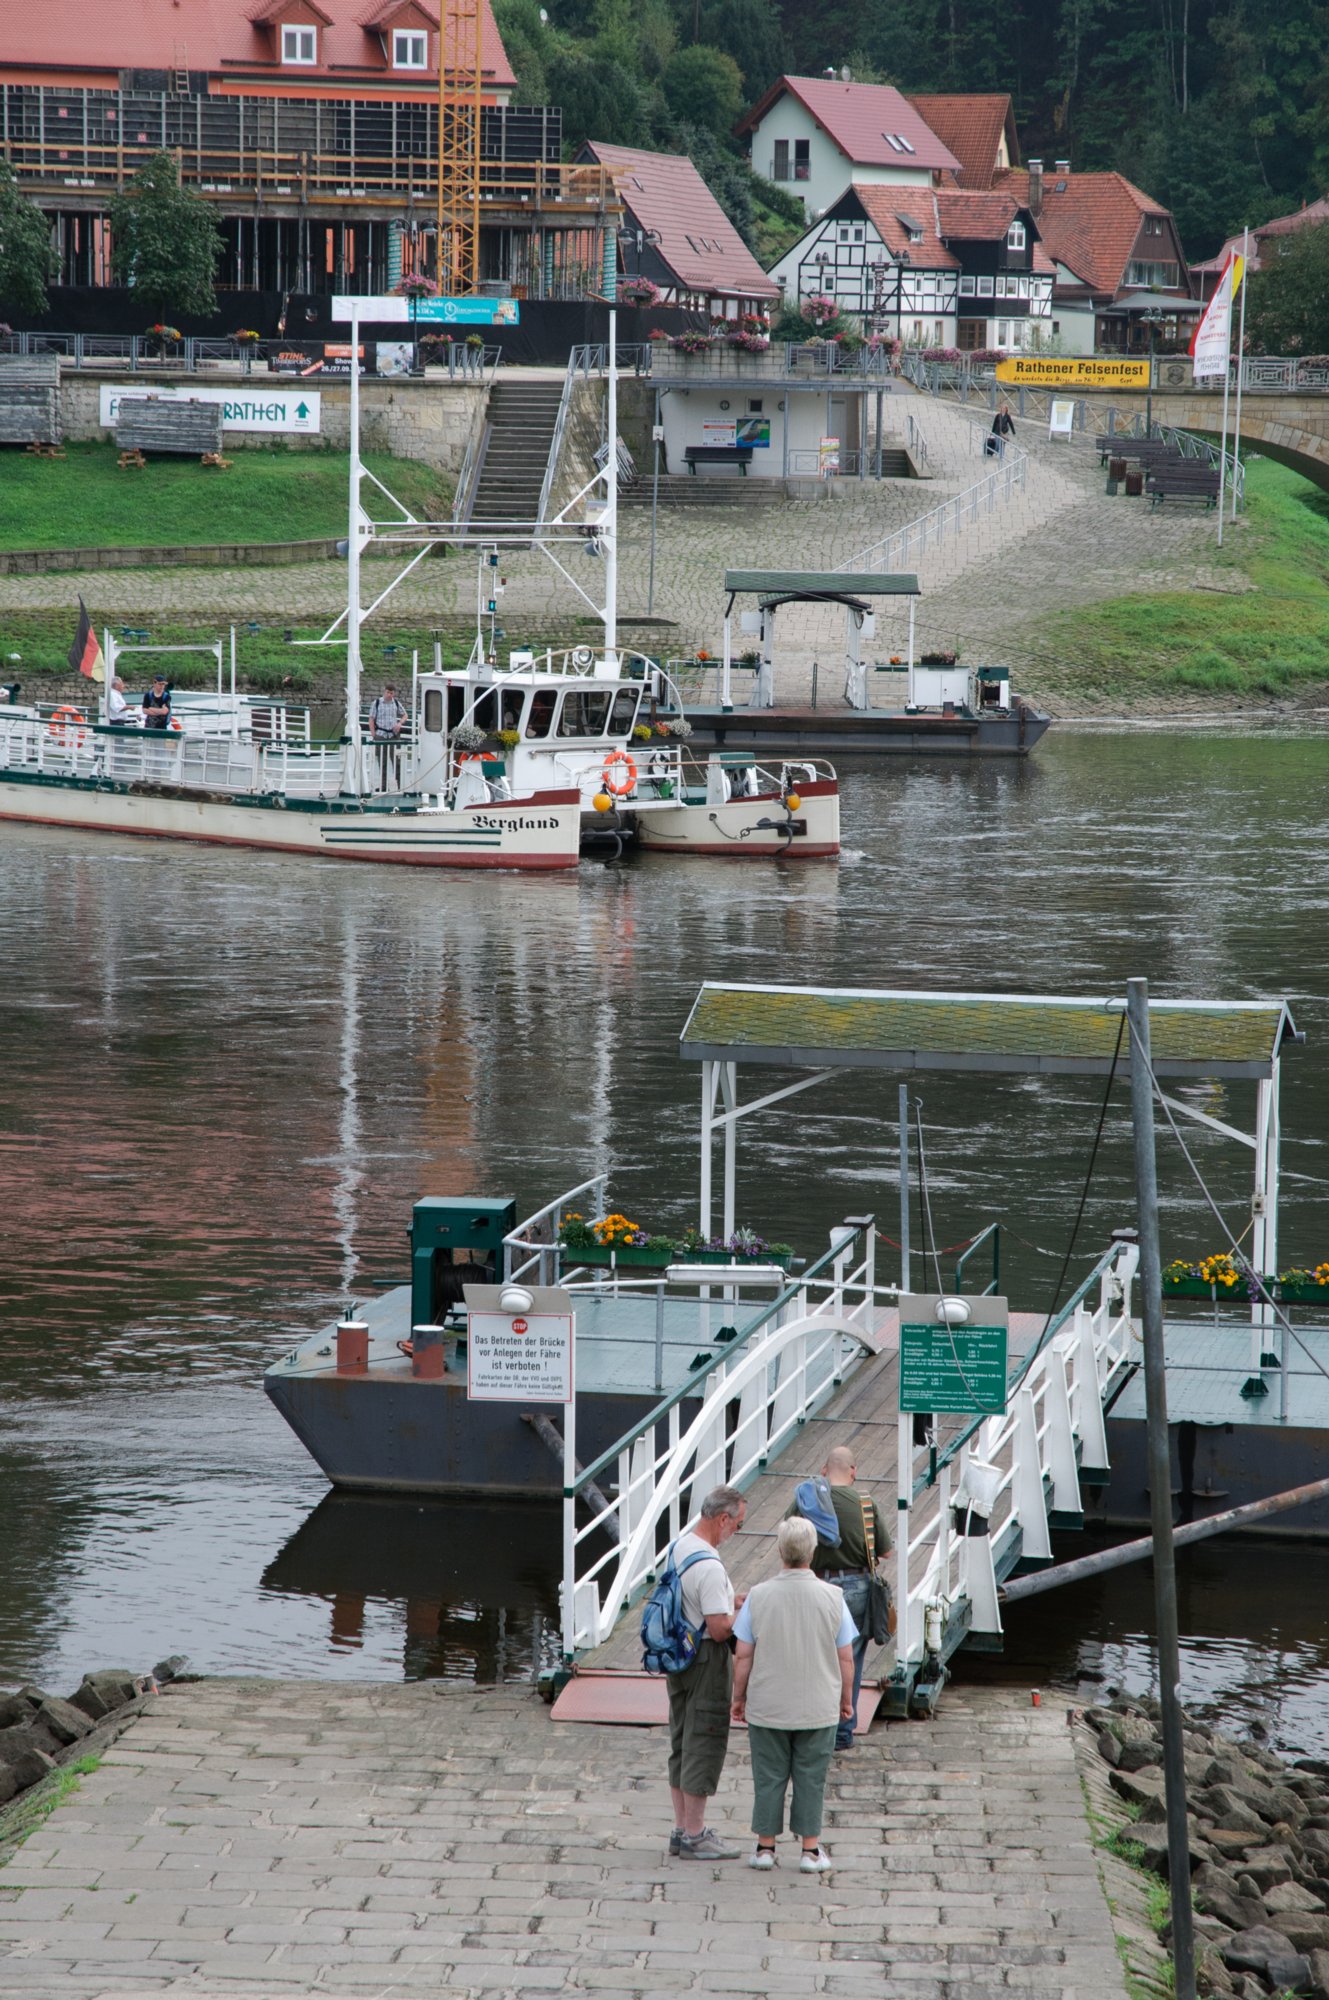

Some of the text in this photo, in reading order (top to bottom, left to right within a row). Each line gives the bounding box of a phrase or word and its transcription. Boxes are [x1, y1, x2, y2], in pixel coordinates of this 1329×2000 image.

[279, 352, 303, 360] STIHL
[1016, 361, 1144, 376] Rathener Felsenfest
[223, 401, 286, 422] RATHEN
[478, 666, 484, 679] F
[472, 815, 559, 833] Bergland
[475, 1335, 565, 1347] Das Betreten der Brücke
[494, 1348, 522, 1359] Anlegen
[525, 1349, 537, 1358] der
[540, 1350, 561, 1359] Fähre
[492, 1360, 502, 1370] ist
[505, 1361, 541, 1371] verboten
